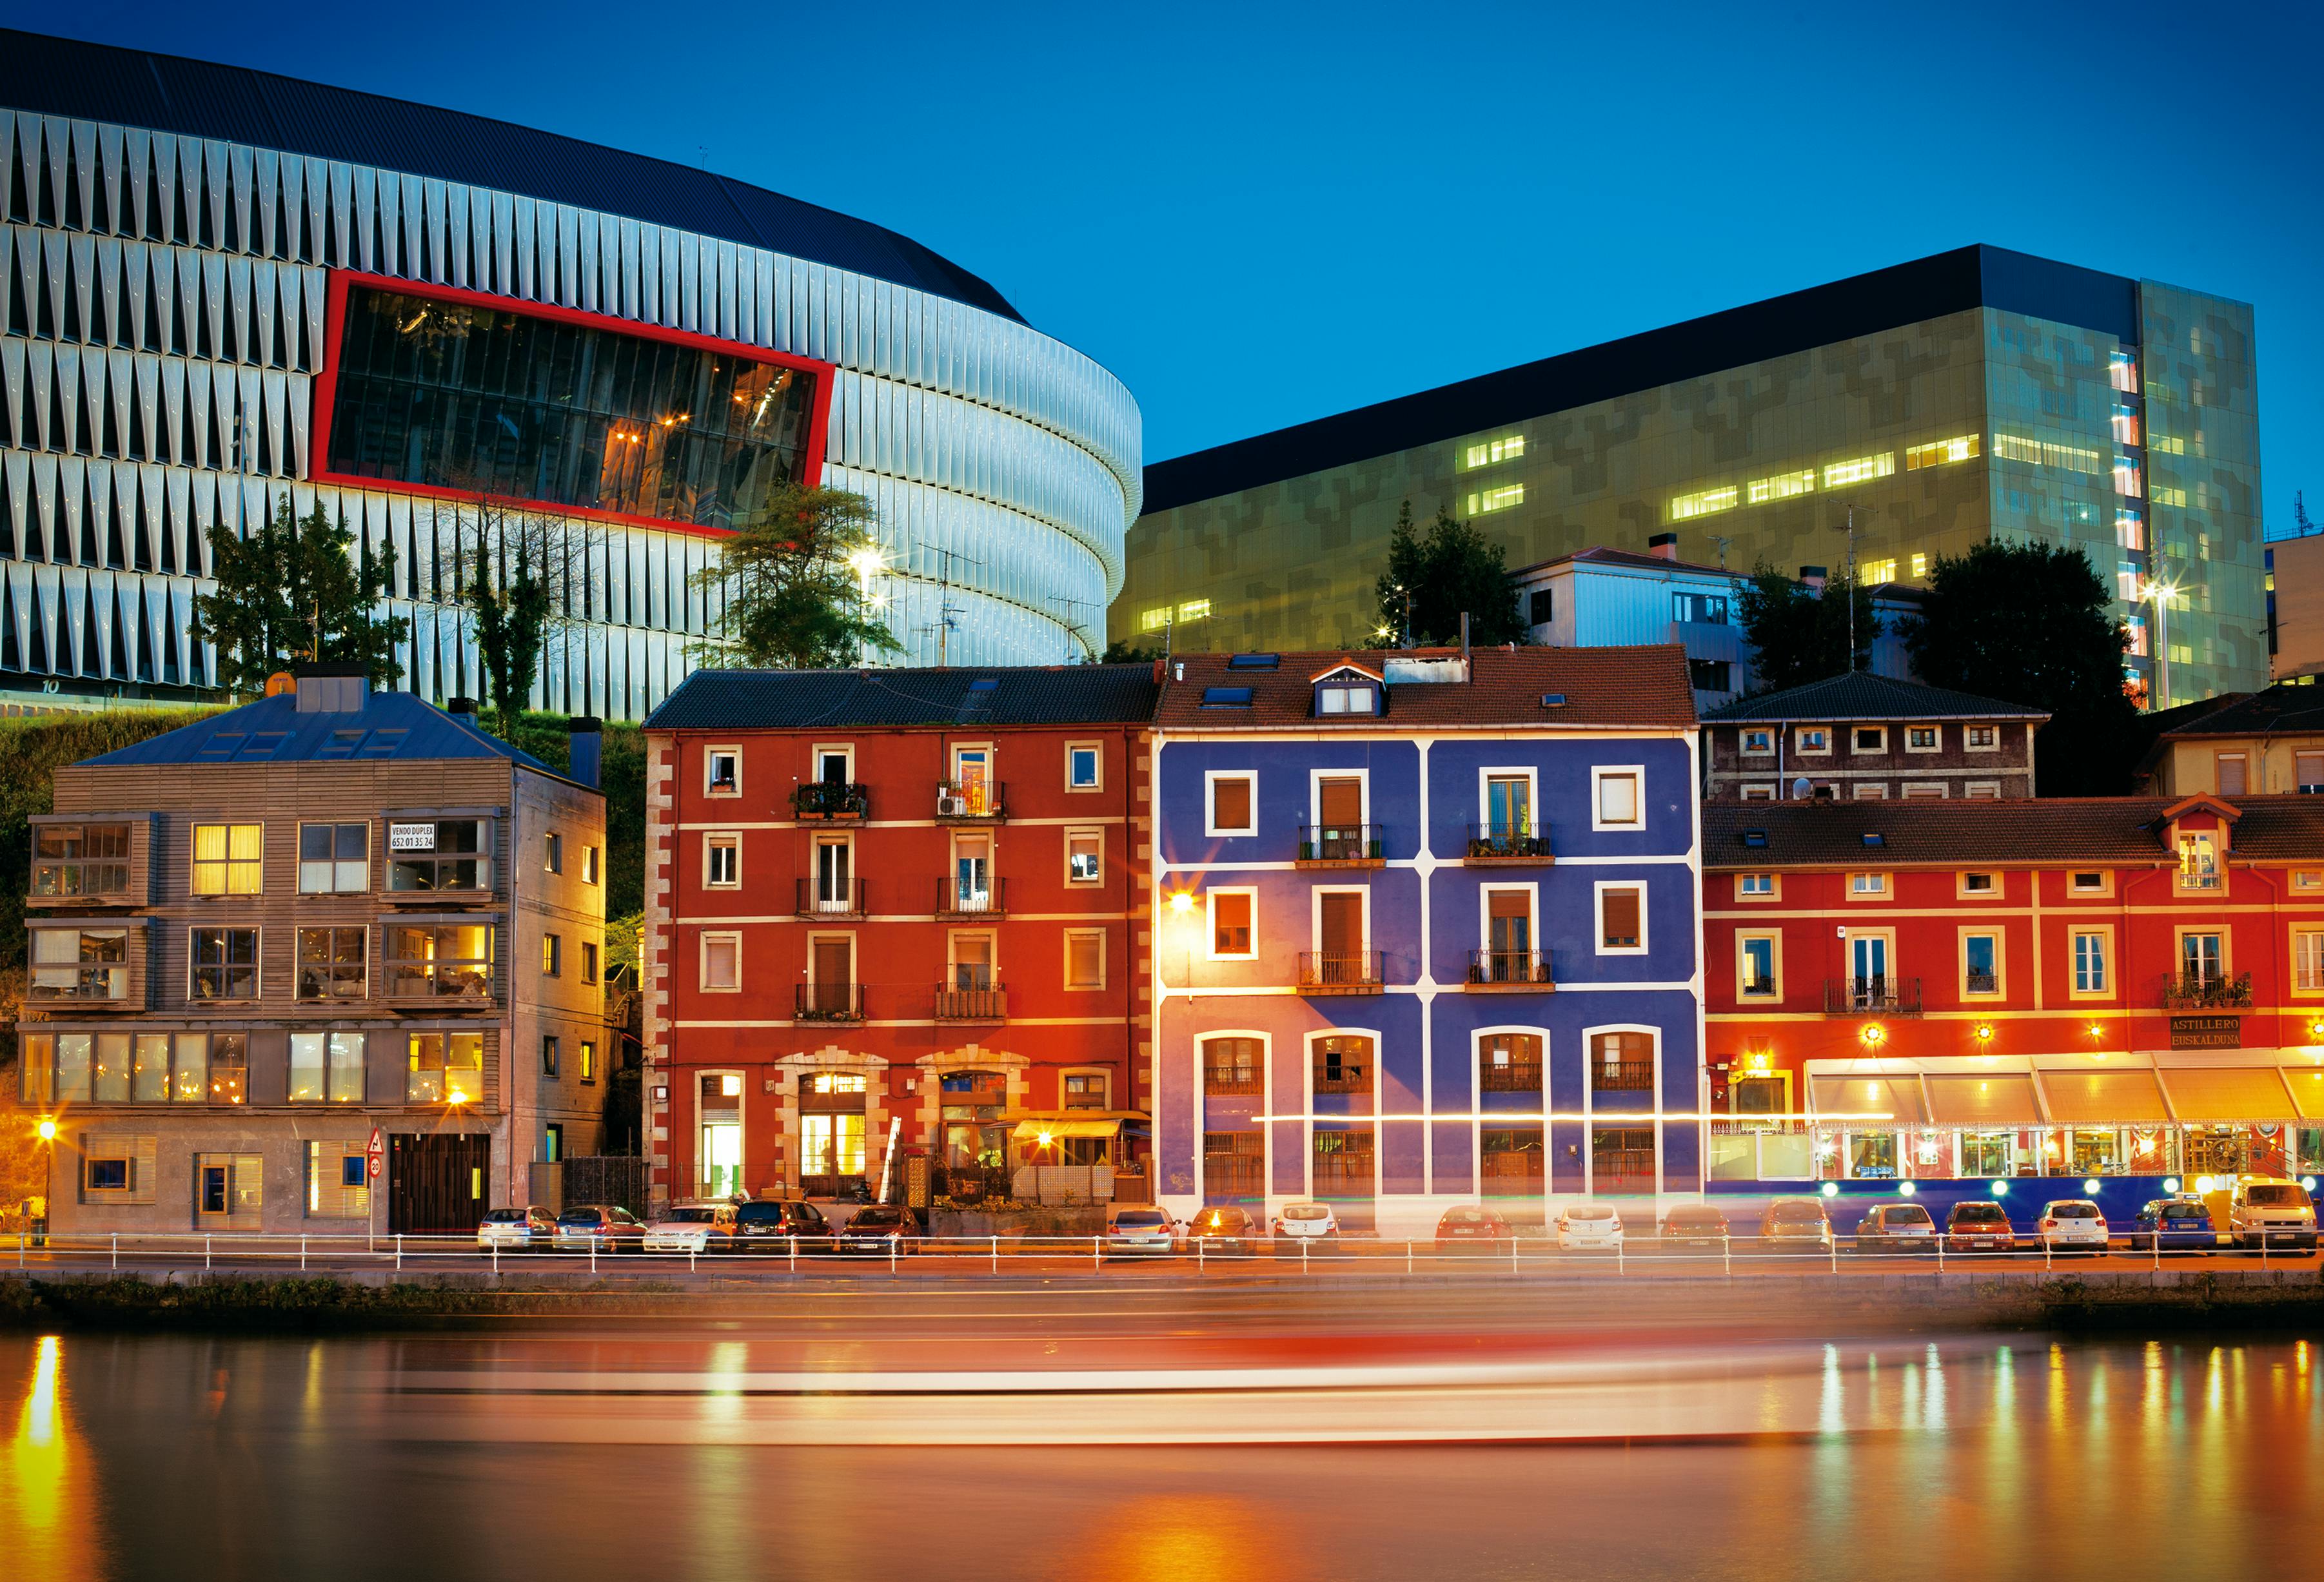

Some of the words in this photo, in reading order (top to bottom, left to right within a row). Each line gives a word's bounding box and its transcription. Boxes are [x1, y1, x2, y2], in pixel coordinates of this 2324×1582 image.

[43, 679, 59, 694] 10
[412, 825, 433, 835] DÚPLEX
[392, 837, 404, 846] 652
[406, 837, 413, 846] 01
[415, 837, 423, 846] 35
[424, 837, 433, 846] 24
[2172, 1019, 2239, 1030] ASTILLERO
[2171, 1034, 2240, 1045] EUSKALDUNA
